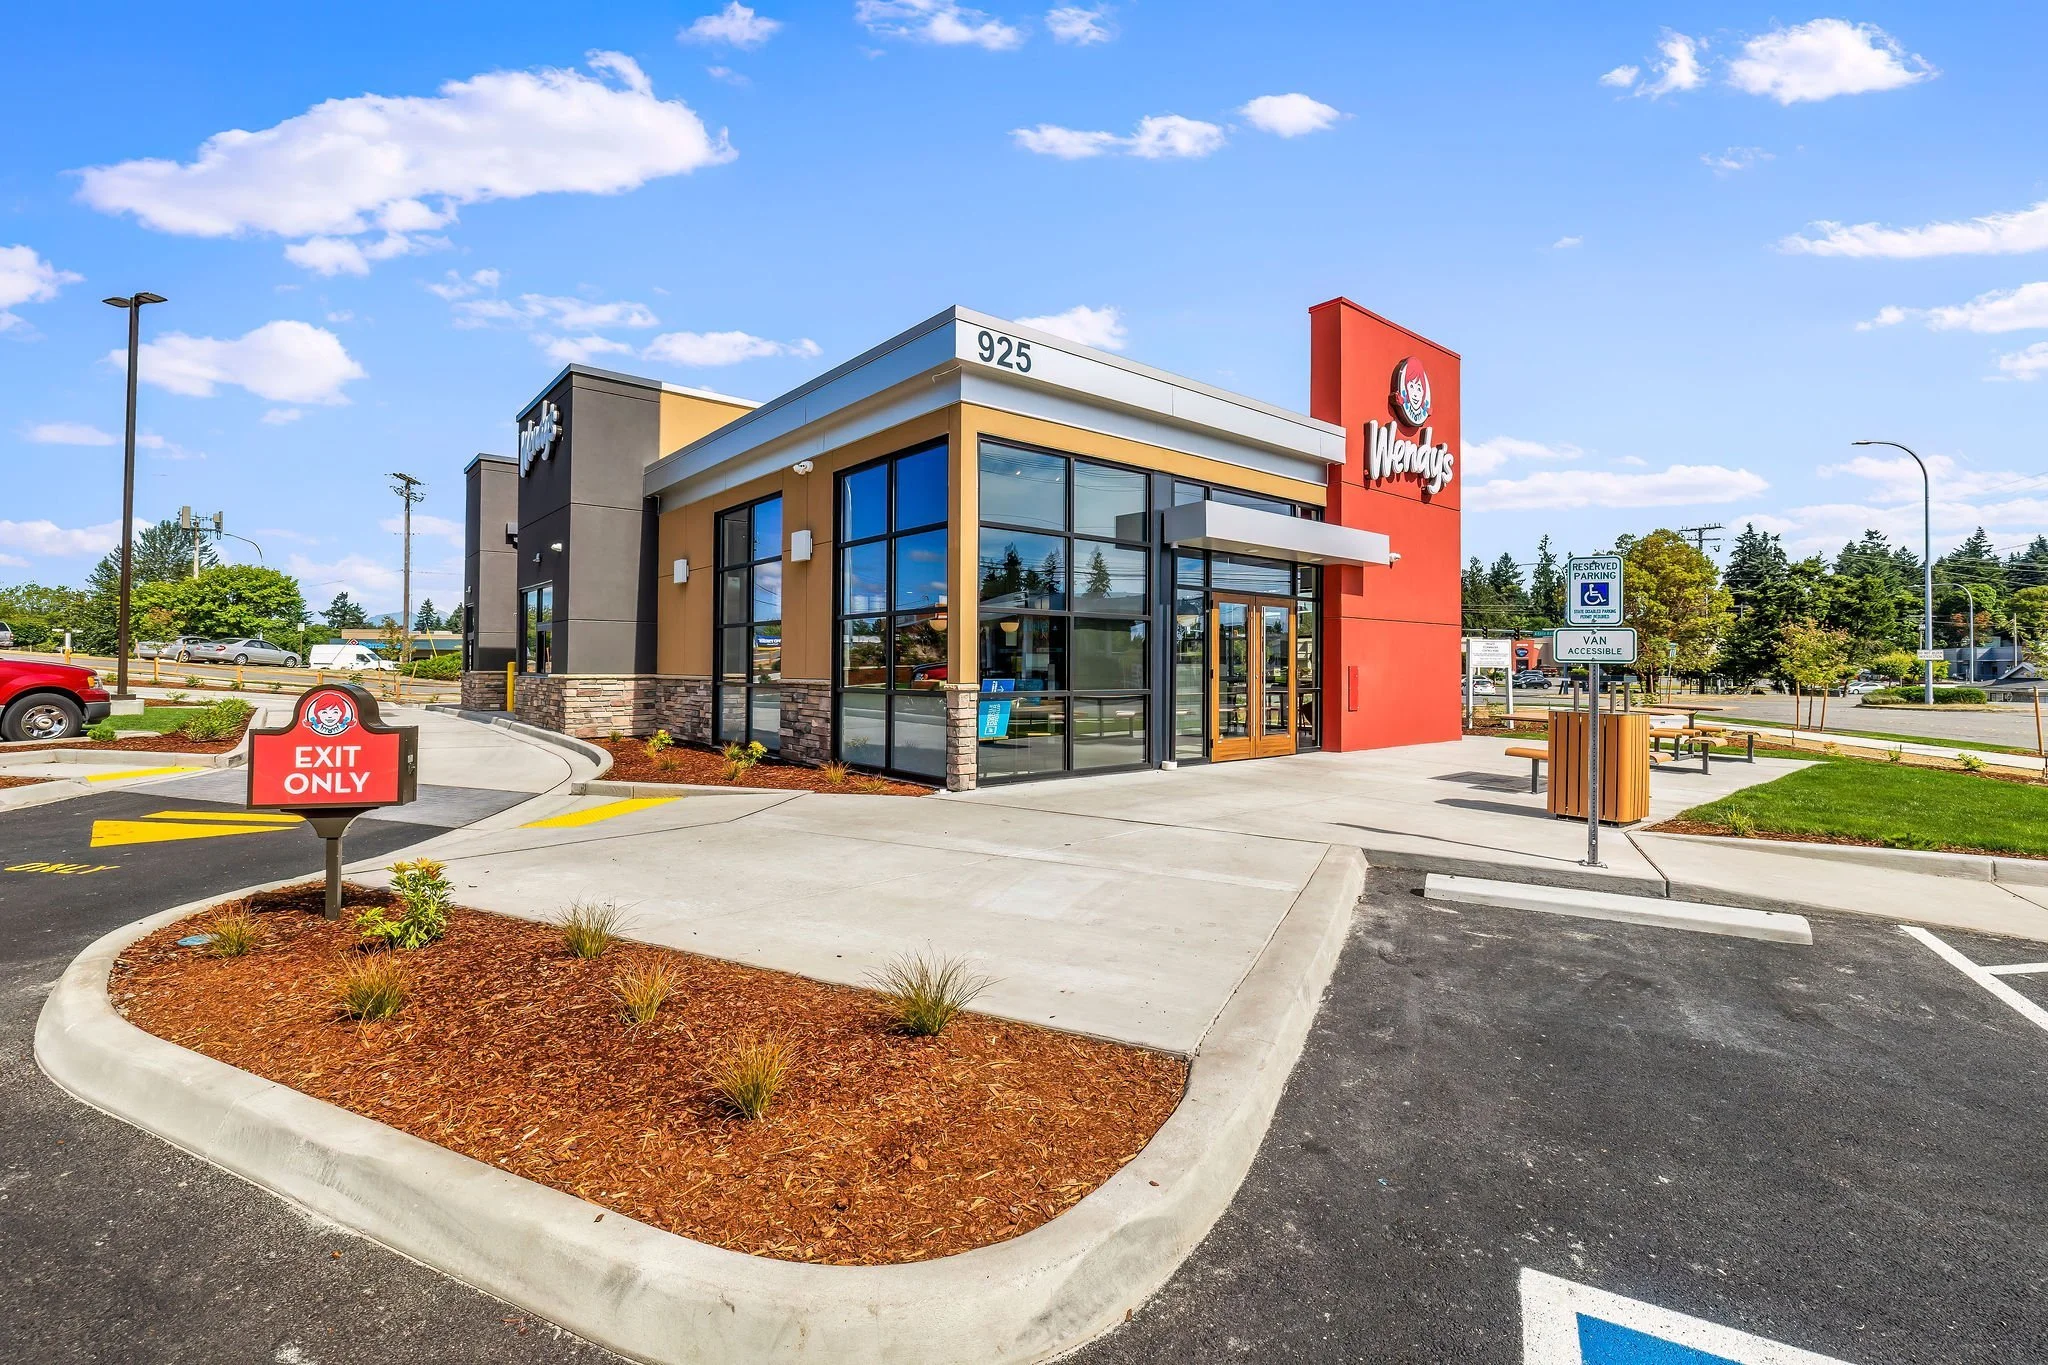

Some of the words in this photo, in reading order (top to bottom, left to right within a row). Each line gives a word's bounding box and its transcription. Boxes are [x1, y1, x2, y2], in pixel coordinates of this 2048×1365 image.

[977, 330, 1032, 373] 925
[1369, 419, 1454, 495] Wendy's
[1572, 562, 1618, 571] RESERVED
[1573, 572, 1617, 580] PARKING
[1583, 636, 1607, 645] VAN
[1568, 647, 1622, 655] ACCESSIBLE
[294, 745, 362, 769] EXIT
[283, 771, 371, 795] ONLY
[4, 862, 121, 875] ONLY
